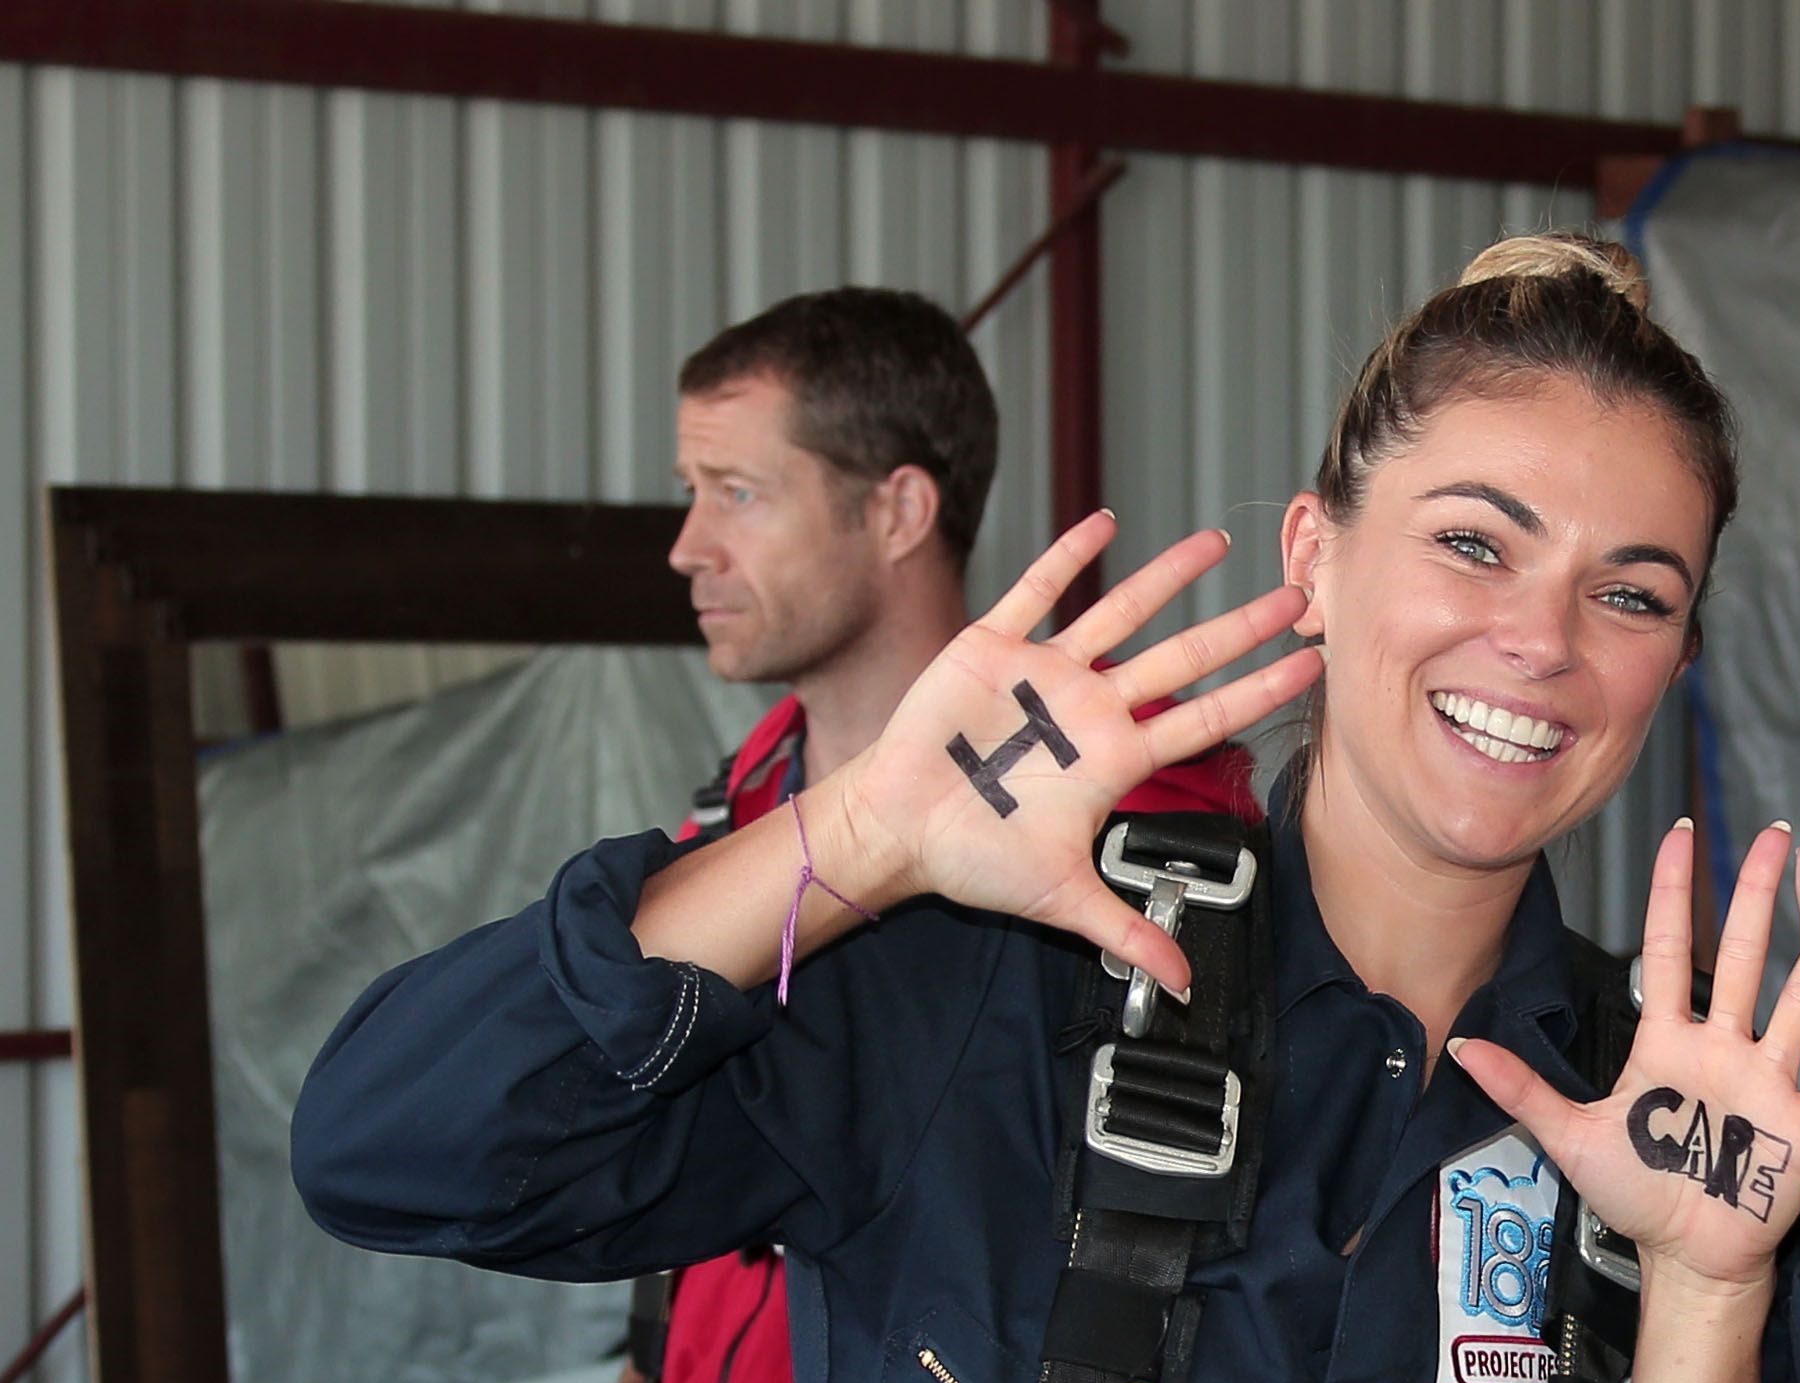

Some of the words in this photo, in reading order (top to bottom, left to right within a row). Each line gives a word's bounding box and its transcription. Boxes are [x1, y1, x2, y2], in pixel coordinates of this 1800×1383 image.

[945, 679, 1081, 819] I
[1627, 1086, 1791, 1223] CARE
[1464, 1350, 1536, 1379] PROJECT
